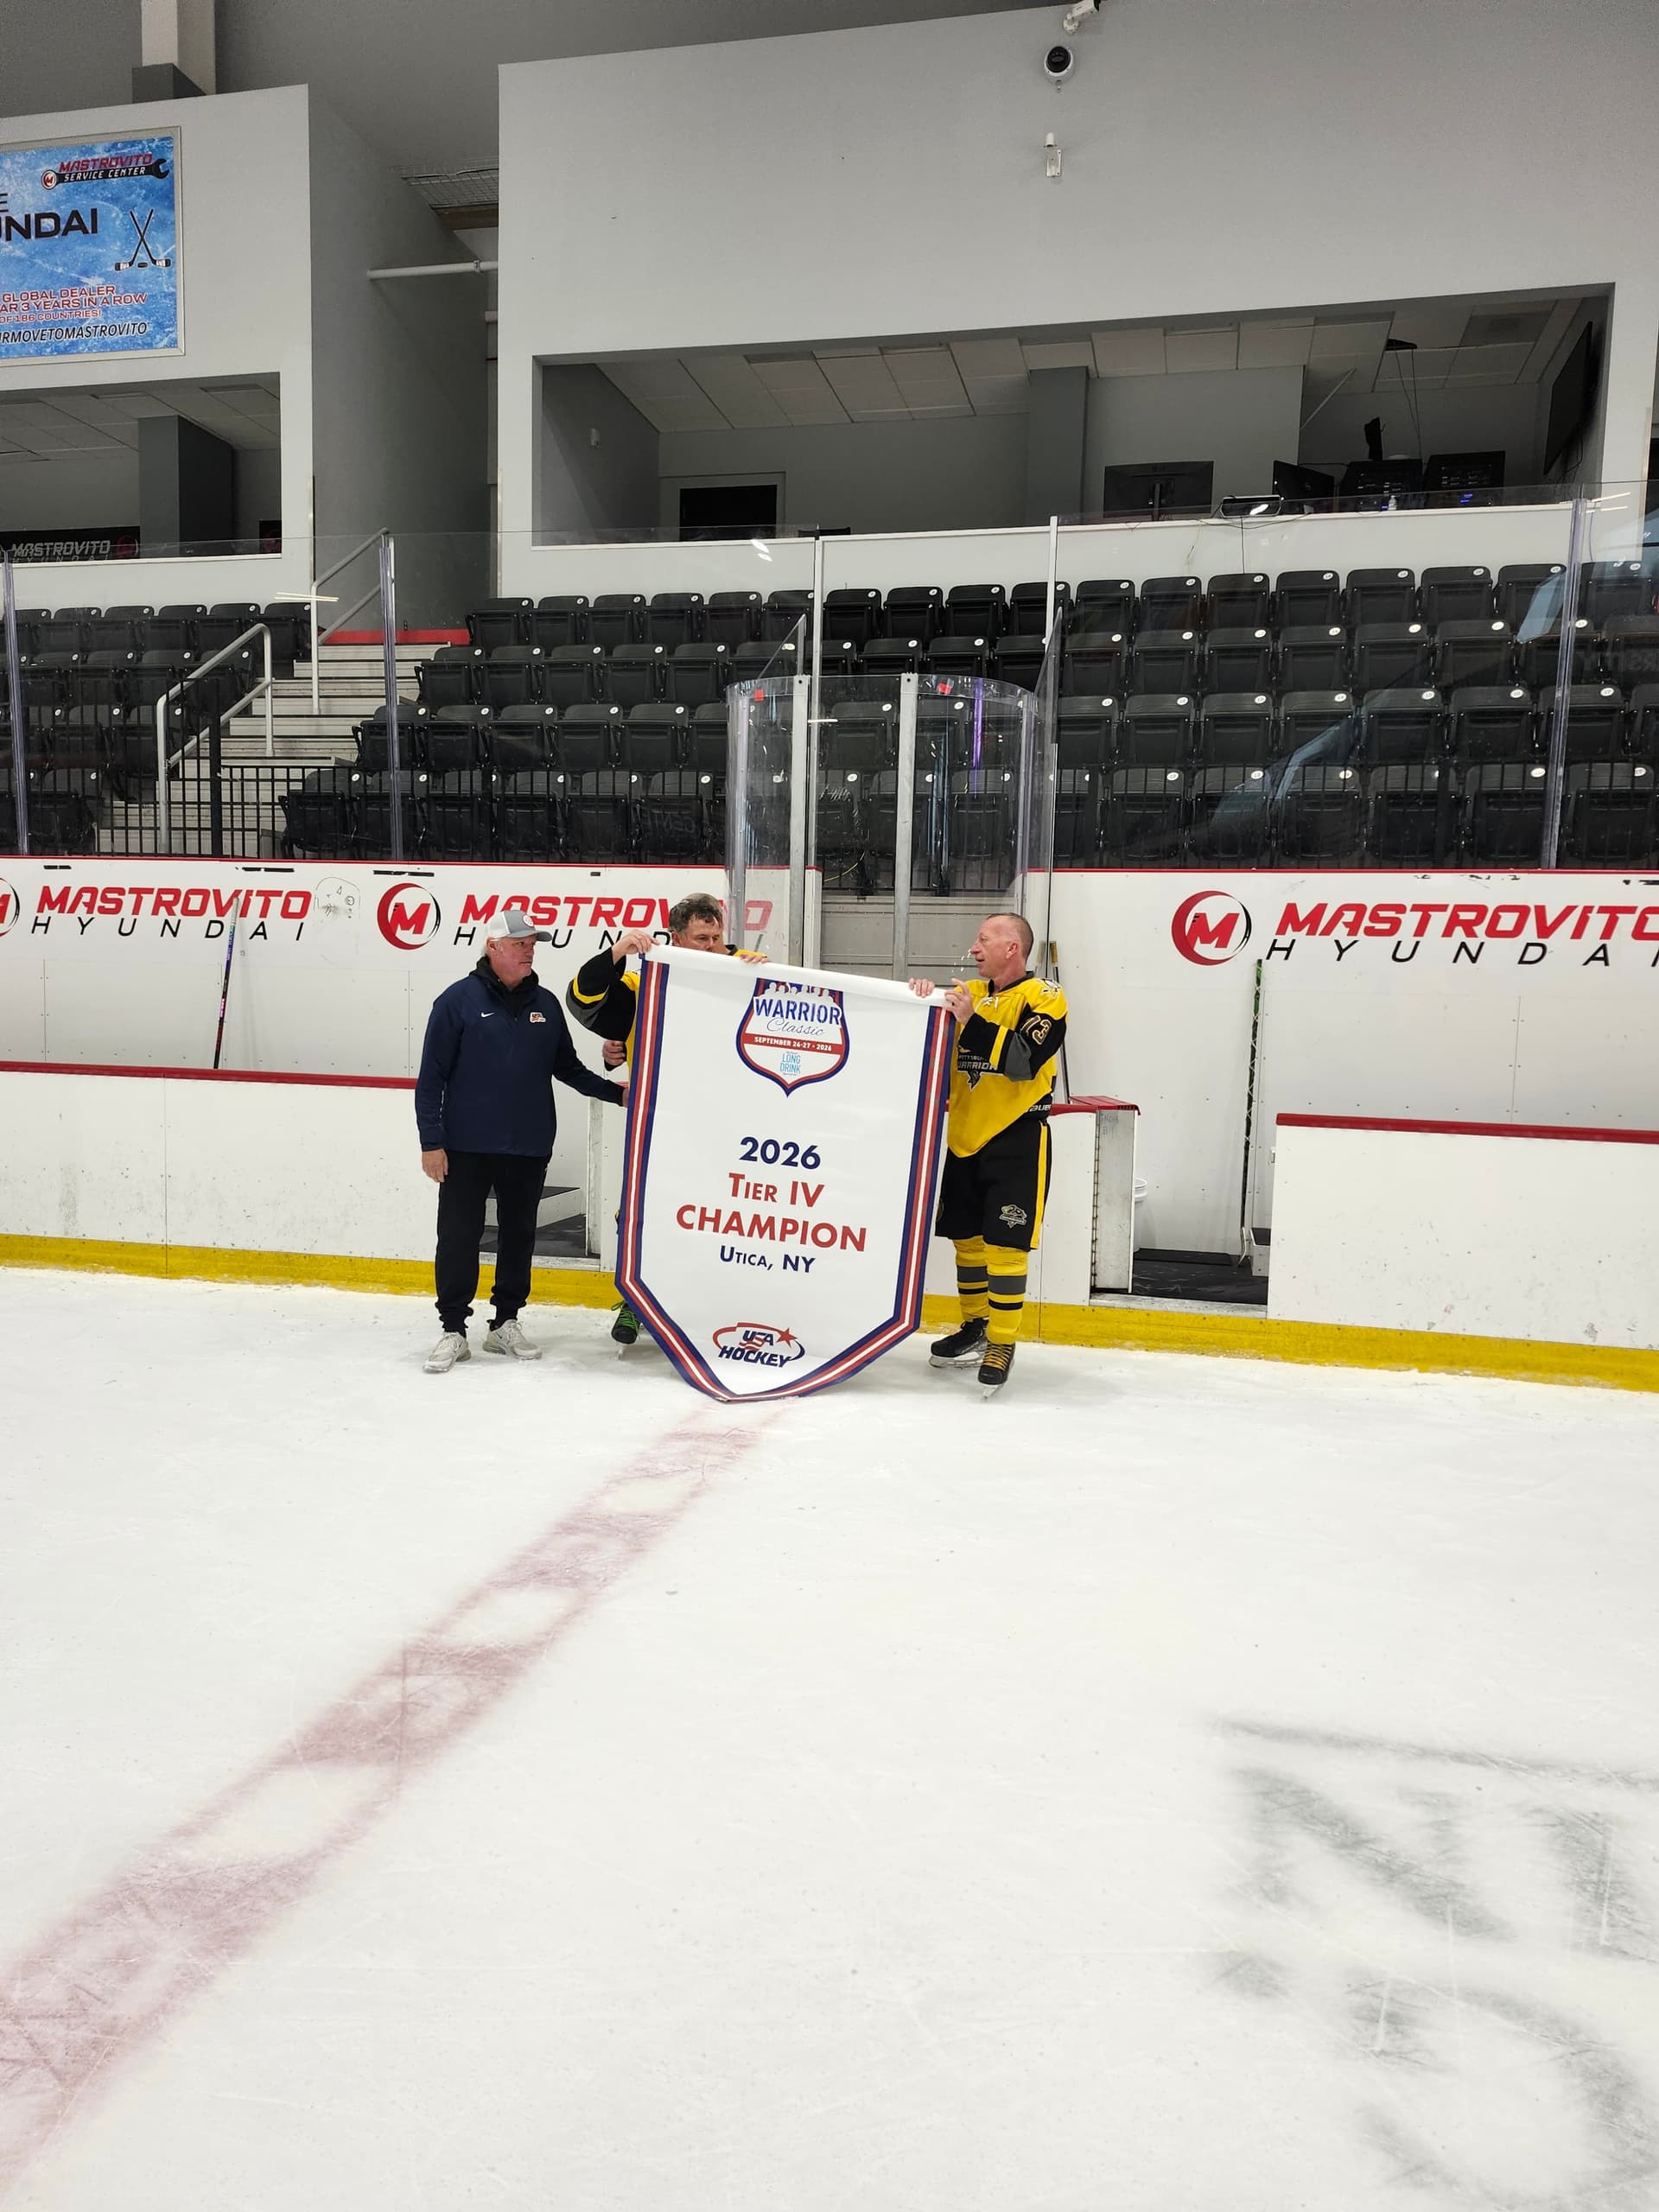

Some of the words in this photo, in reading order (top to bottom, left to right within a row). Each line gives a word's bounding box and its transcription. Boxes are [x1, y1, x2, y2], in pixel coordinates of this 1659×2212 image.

[59, 153, 153, 173] MASTROVITO
[64, 170, 104, 182] SERVICE
[108, 166, 146, 179] CENTER
[0, 207, 99, 242] NDAI
[3, 290, 57, 302] GLOBAL
[60, 285, 116, 298] DEALER
[22, 302, 30, 312] 3
[35, 298, 80, 310] YEARS
[85, 297, 97, 307] IN
[101, 296, 111, 305] A
[113, 294, 148, 304] ROW
[16, 314, 35, 322] 186
[37, 309, 103, 321] COUNTRIES!
[0, 322, 148, 343] RMOVETOMASTROVITO
[12, 539, 111, 558] MASTROVITO
[37, 886, 313, 920] MASTROVITO
[31, 916, 304, 942] HYUNDAI
[1274, 902, 1659, 941] MASTROVITO
[1266, 938, 1659, 968] HYUNDAI
[755, 998, 841, 1026] WARRIOR
[766, 1018, 824, 1036] Classic
[754, 1036, 791, 1046] SEPTEMBER
[779, 1062, 801, 1074] DRINK
[782, 1053, 801, 1064] LONG
[739, 1136, 822, 1170] 2026
[790, 1180, 825, 1208] IV
[676, 1204, 868, 1252] CHAMPION
[782, 1254, 817, 1274] NY
[741, 1330, 774, 1350] USA
[718, 1345, 792, 1368] HOCKEY
